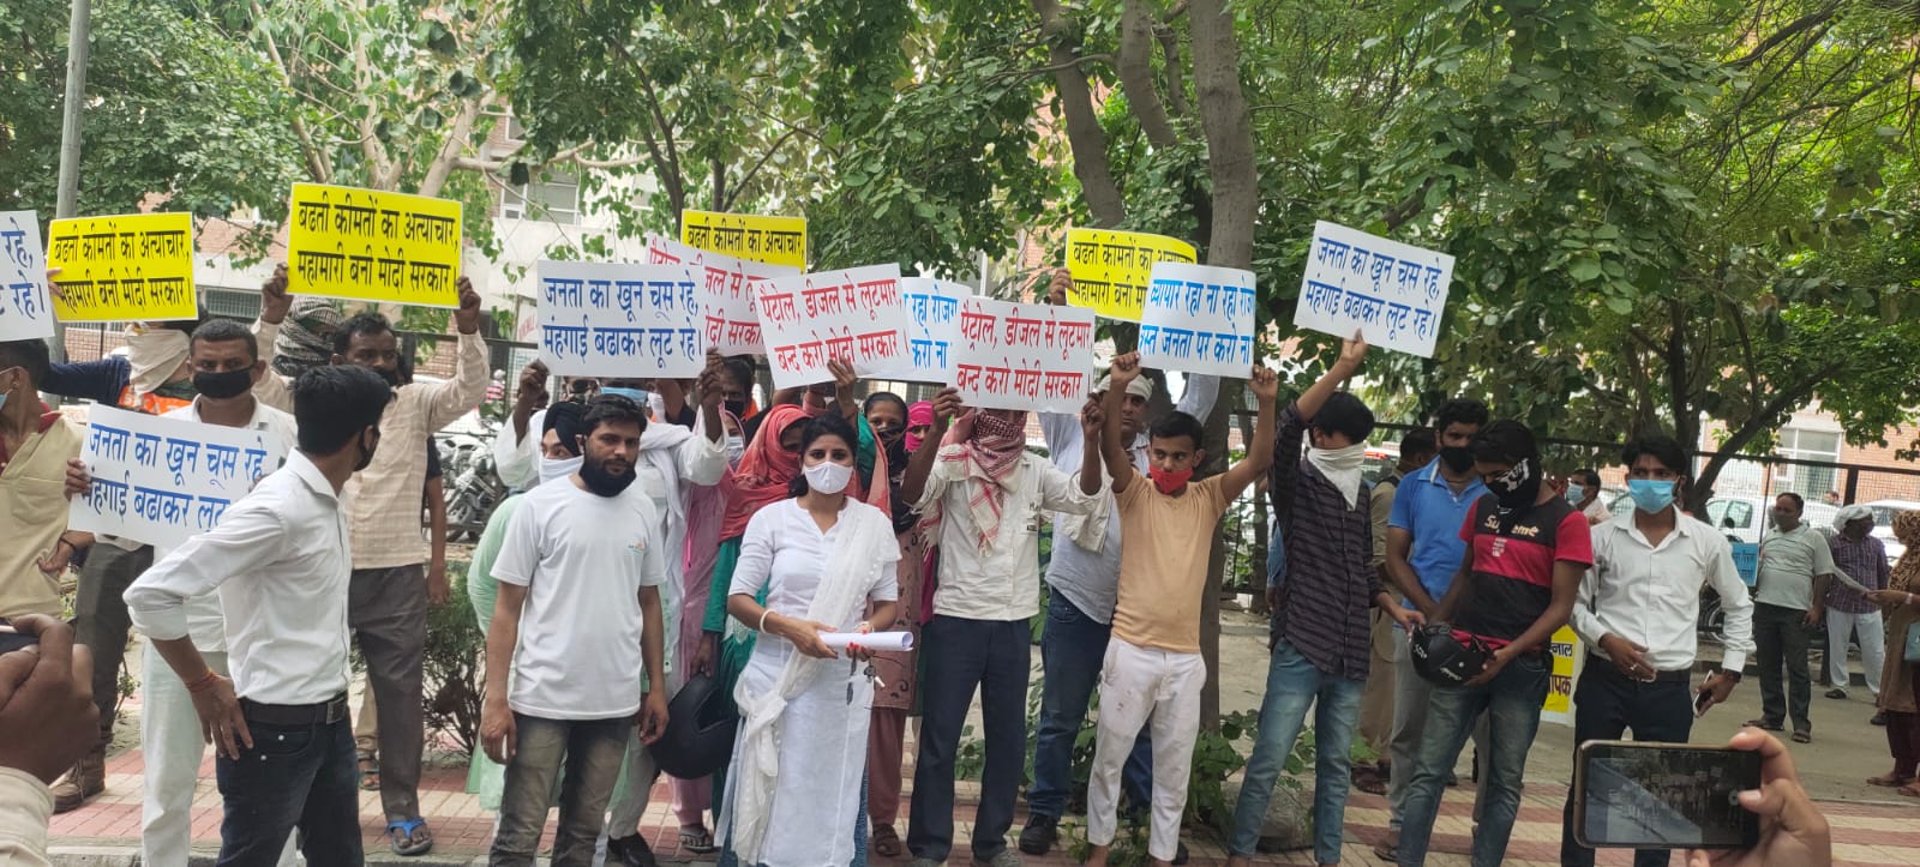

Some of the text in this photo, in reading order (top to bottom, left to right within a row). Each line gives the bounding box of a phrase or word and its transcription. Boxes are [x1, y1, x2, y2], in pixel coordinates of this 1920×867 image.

[1, 217, 33, 269] रहे,
[55, 221, 190, 264] बढती कीमतों का अत्याचार,
[299, 191, 458, 253] बढती कीमतों का अत्याचार,
[713, 218, 746, 252] कीमतों
[748, 229, 762, 254] का
[297, 241, 345, 287] महामारी
[349, 245, 374, 286] बनी
[378, 246, 405, 294] मोदी
[1073, 233, 1099, 265] बढती
[1102, 235, 1136, 270] कीमतों
[1139, 247, 1153, 271] का
[1317, 237, 1442, 299] जनता का खून चूस रहे,
[97, 268, 120, 308] बनी
[121, 267, 146, 312] मोदी
[543, 277, 584, 308] जनता
[588, 279, 611, 309] का
[615, 280, 645, 323] खून
[648, 281, 674, 322] चूस
[678, 269, 699, 317] रहे,
[731, 262, 743, 300] से
[802, 279, 841, 319] डीजल
[843, 273, 857, 314] से
[1073, 272, 1111, 306] महामारी
[1114, 275, 1133, 308] बनी
[1151, 279, 1183, 312] व्यापार
[1185, 282, 1204, 317] रहा
[1206, 285, 1220, 316] ना
[1222, 286, 1238, 321] रहा
[911, 293, 929, 328] रहा
[1004, 306, 1042, 348] डीजल
[1045, 308, 1056, 348] से
[1306, 273, 1345, 321] मंहगाई
[1344, 290, 1385, 325] बढाकर
[1386, 302, 1411, 341] लूट
[542, 315, 589, 364] मंहगाई
[593, 327, 645, 357] बढाकर
[648, 328, 675, 369] लूट
[728, 321, 765, 347] सरका
[775, 344, 803, 375] बन्द
[800, 330, 825, 370] करो
[826, 325, 855, 366] मोदी
[935, 340, 949, 370] ना
[1162, 327, 1194, 358] जनता
[1197, 332, 1212, 362] पर
[1214, 323, 1238, 363] करो
[1240, 335, 1250, 364] ना
[956, 363, 982, 397] बन्द
[985, 357, 1011, 395] करो
[1014, 358, 1042, 402] मोदी
[89, 423, 131, 463] जनता
[134, 432, 162, 468] का
[166, 437, 202, 487] खून
[206, 443, 240, 490] चूस
[133, 485, 195, 528] बढाकर
